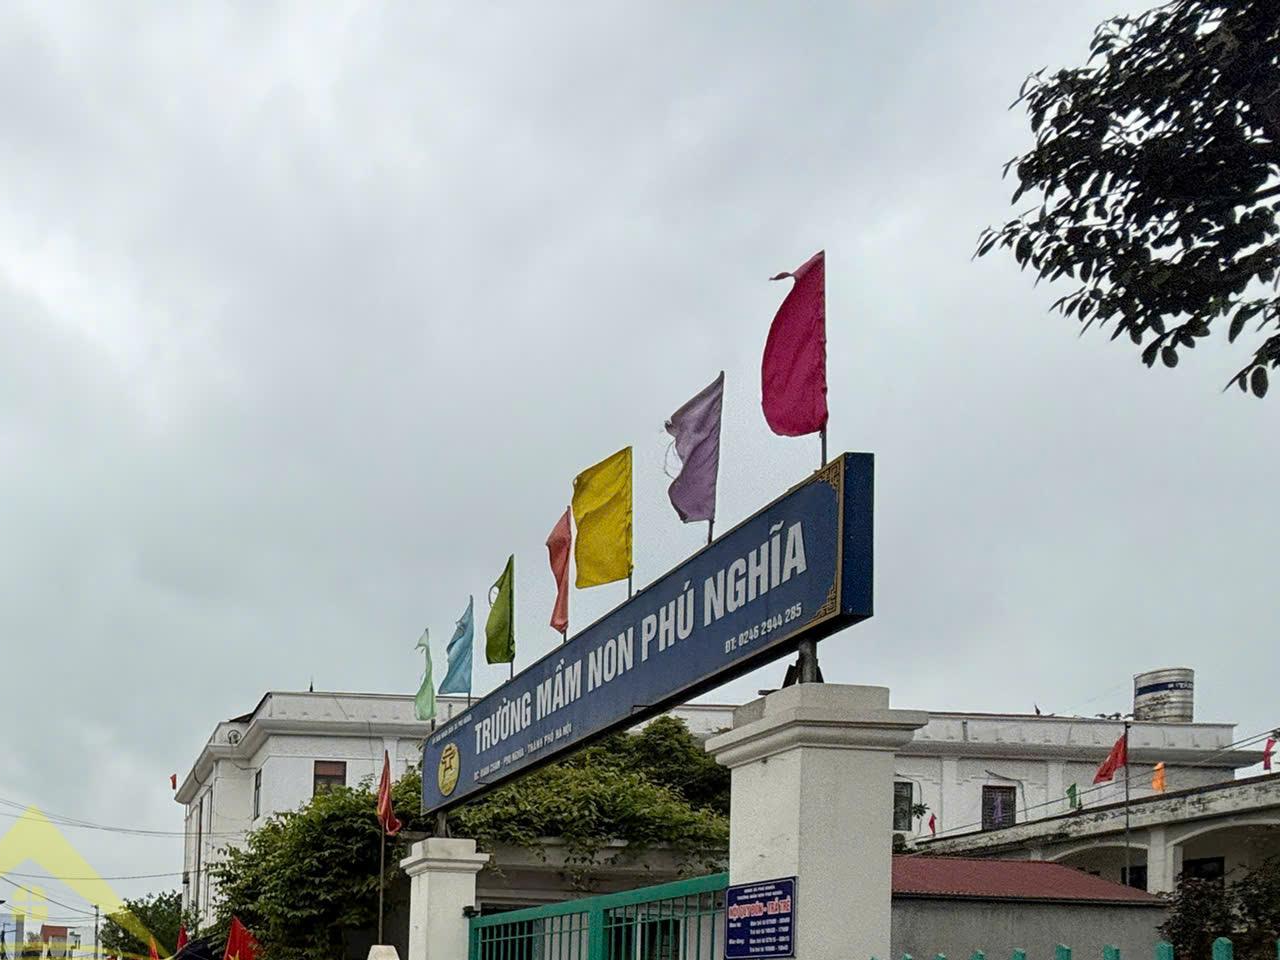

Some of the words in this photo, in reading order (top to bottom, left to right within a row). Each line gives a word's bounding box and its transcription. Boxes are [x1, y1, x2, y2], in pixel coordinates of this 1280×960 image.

[474, 691, 532, 755] TRƯỜNG
[536, 658, 582, 722] MẦM
[587, 627, 634, 692] NON
[641, 580, 695, 662] PHÚ
[703, 520, 807, 627] NGHĨA
[760, 613, 783, 636] 2944
[784, 602, 802, 624] 285
